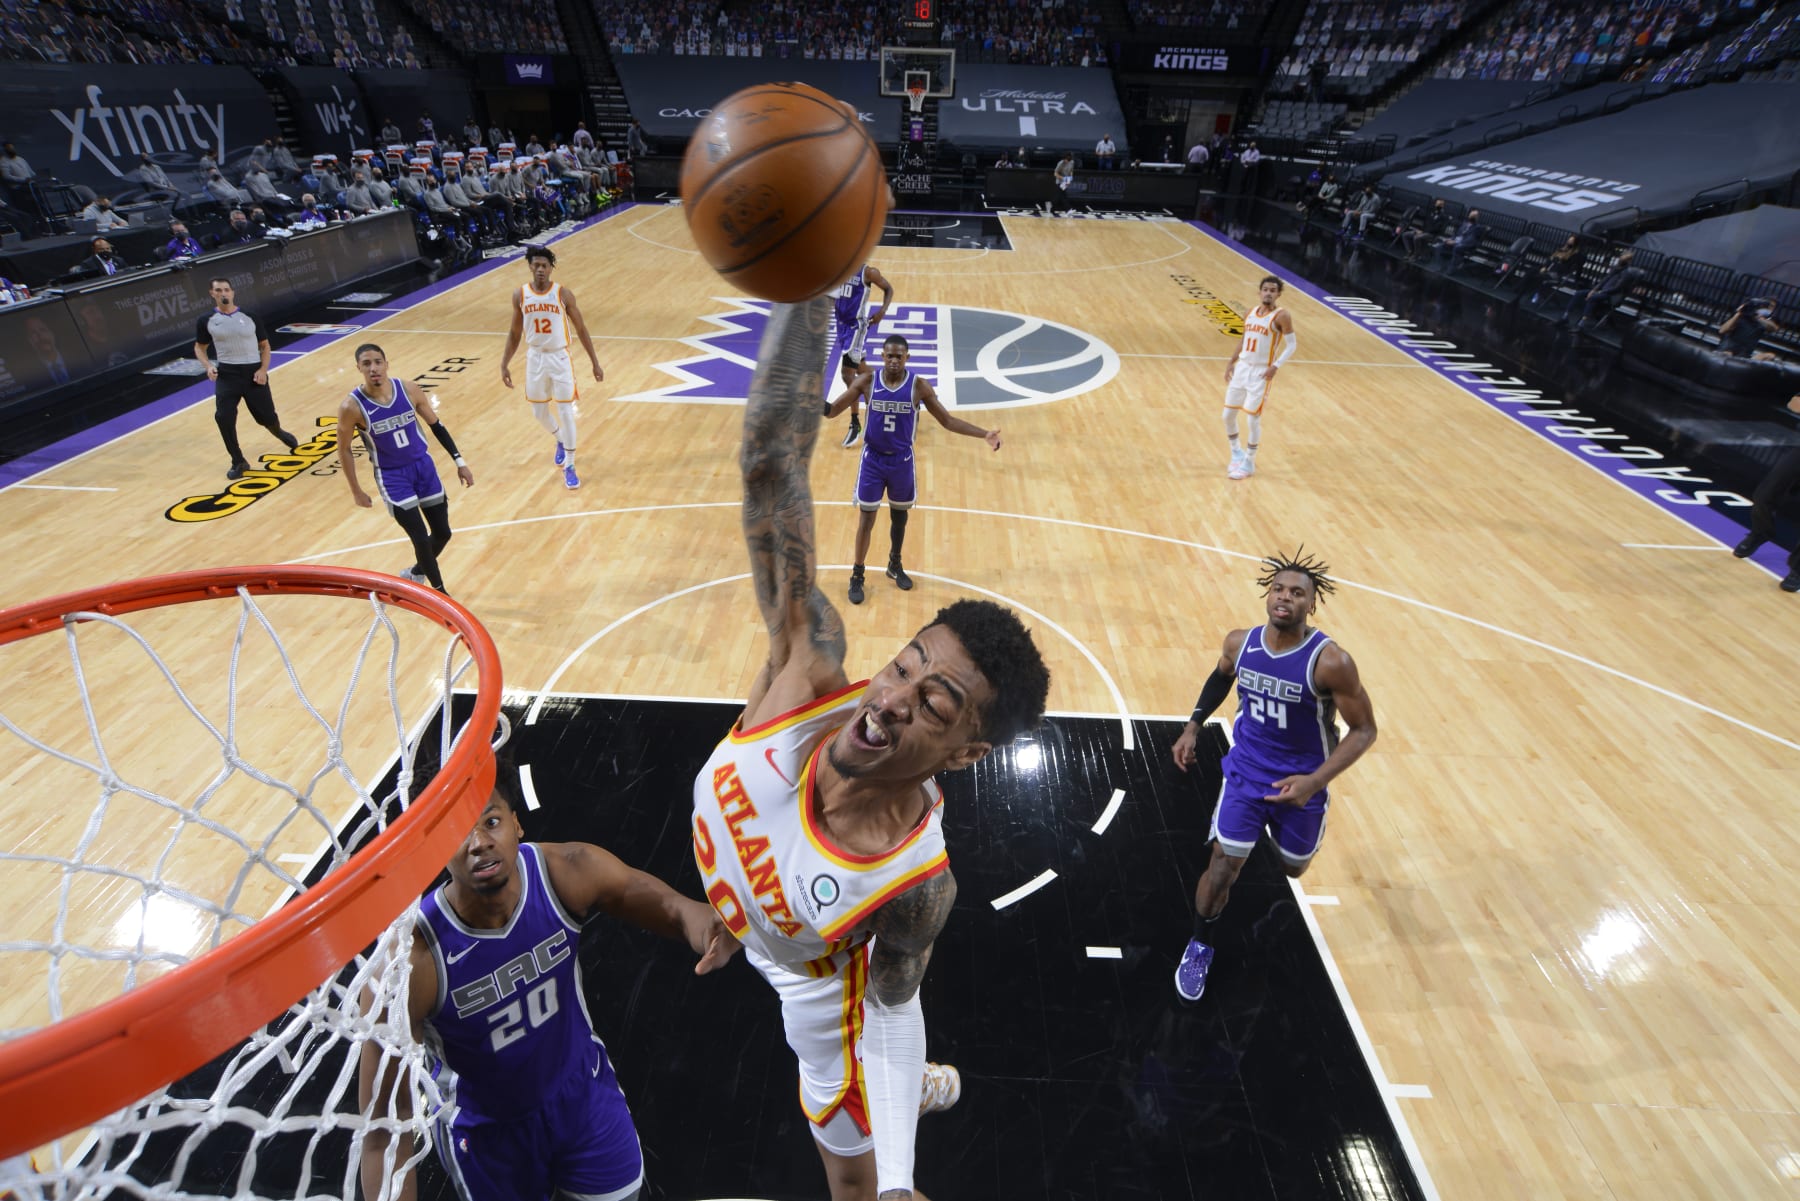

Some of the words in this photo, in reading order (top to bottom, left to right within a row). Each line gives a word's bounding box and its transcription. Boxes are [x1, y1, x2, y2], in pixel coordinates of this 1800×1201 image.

[915, 0, 930, 19] 18
[1160, 46, 1226, 55] SACRAMENTO
[1154, 54, 1229, 71] KINGS
[980, 88, 1069, 100] Michelob
[658, 108, 713, 118] CAC
[961, 97, 1097, 115] ULTRA
[51, 84, 225, 178] xfinity
[898, 174, 931, 182] CACHE
[898, 181, 931, 190] CREEK
[1468, 159, 1642, 193] SACRAMENTO
[1406, 165, 1625, 213] KINGS
[137, 294, 190, 327] DAVE
[524, 303, 561, 314] ATLANTA
[1323, 296, 1435, 337] PROUD
[533, 318, 553, 334] 12
[1245, 337, 1258, 353] 11
[872, 399, 912, 414] SAC
[371, 410, 417, 436] SAC
[883, 414, 897, 433] 5
[1398, 339, 1755, 507] SACRAMENTO
[393, 429, 410, 449] 0
[1238, 666, 1303, 703] SAC
[1247, 693, 1287, 729] 24
[713, 761, 805, 939] ATLANTA
[692, 814, 751, 940] 20
[795, 874, 817, 921] sharecare
[450, 928, 571, 1020] SAC
[487, 977, 560, 1053] 20
